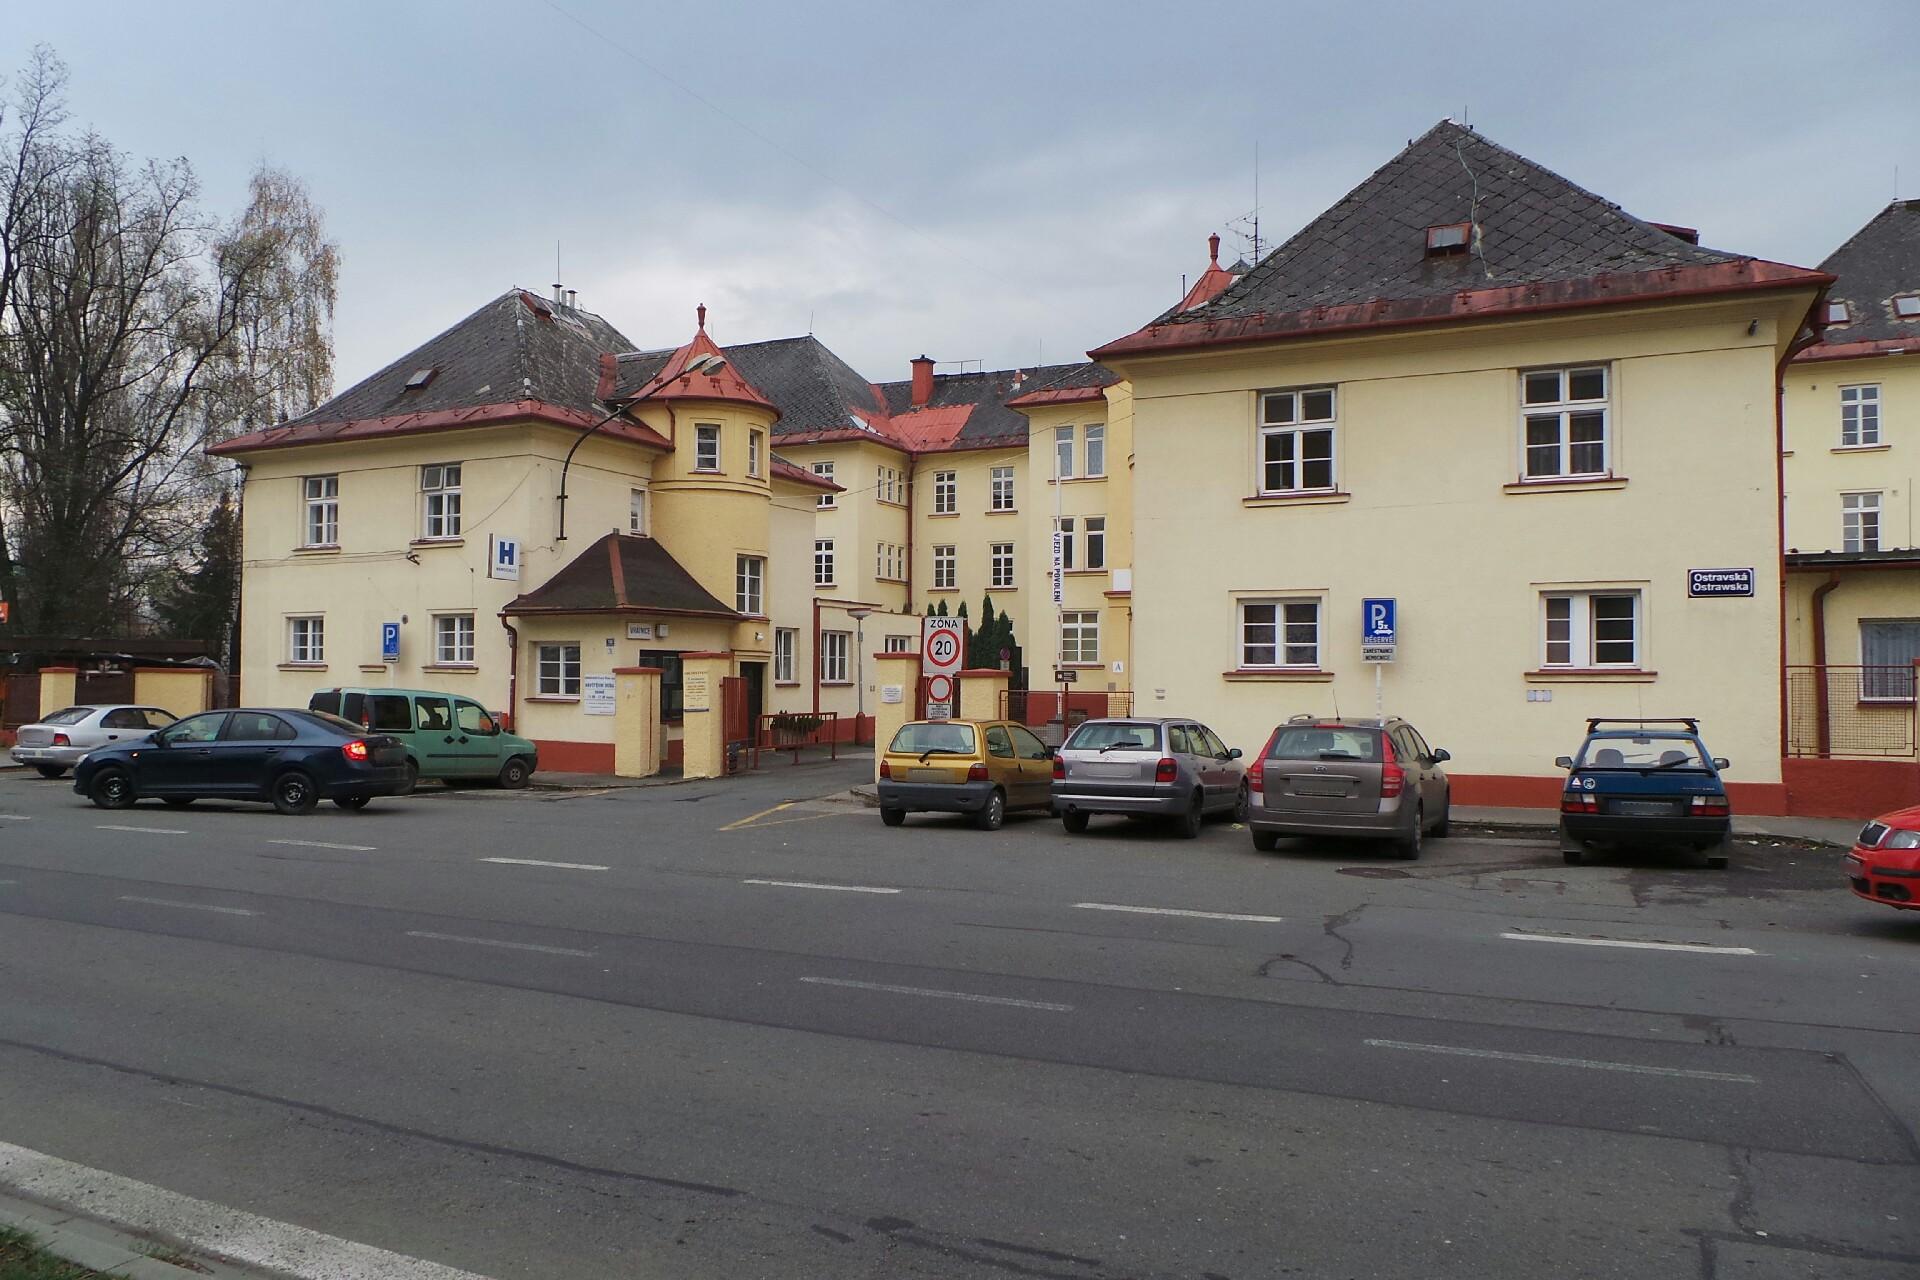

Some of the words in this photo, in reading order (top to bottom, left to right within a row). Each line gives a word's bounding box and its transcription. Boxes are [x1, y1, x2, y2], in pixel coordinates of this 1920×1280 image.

[1053, 533, 1061, 553] VJEZD
[499, 541, 515, 565] H
[1053, 556, 1061, 566] NA
[1694, 573, 1748, 581] Ostravská
[1692, 582, 1749, 591] Ostrawska
[930, 617, 958, 628] ZÓNA
[1371, 604, 1386, 629] P
[1377, 620, 1388, 629] 5x
[386, 627, 396, 645] P
[935, 640, 952, 656] 20
